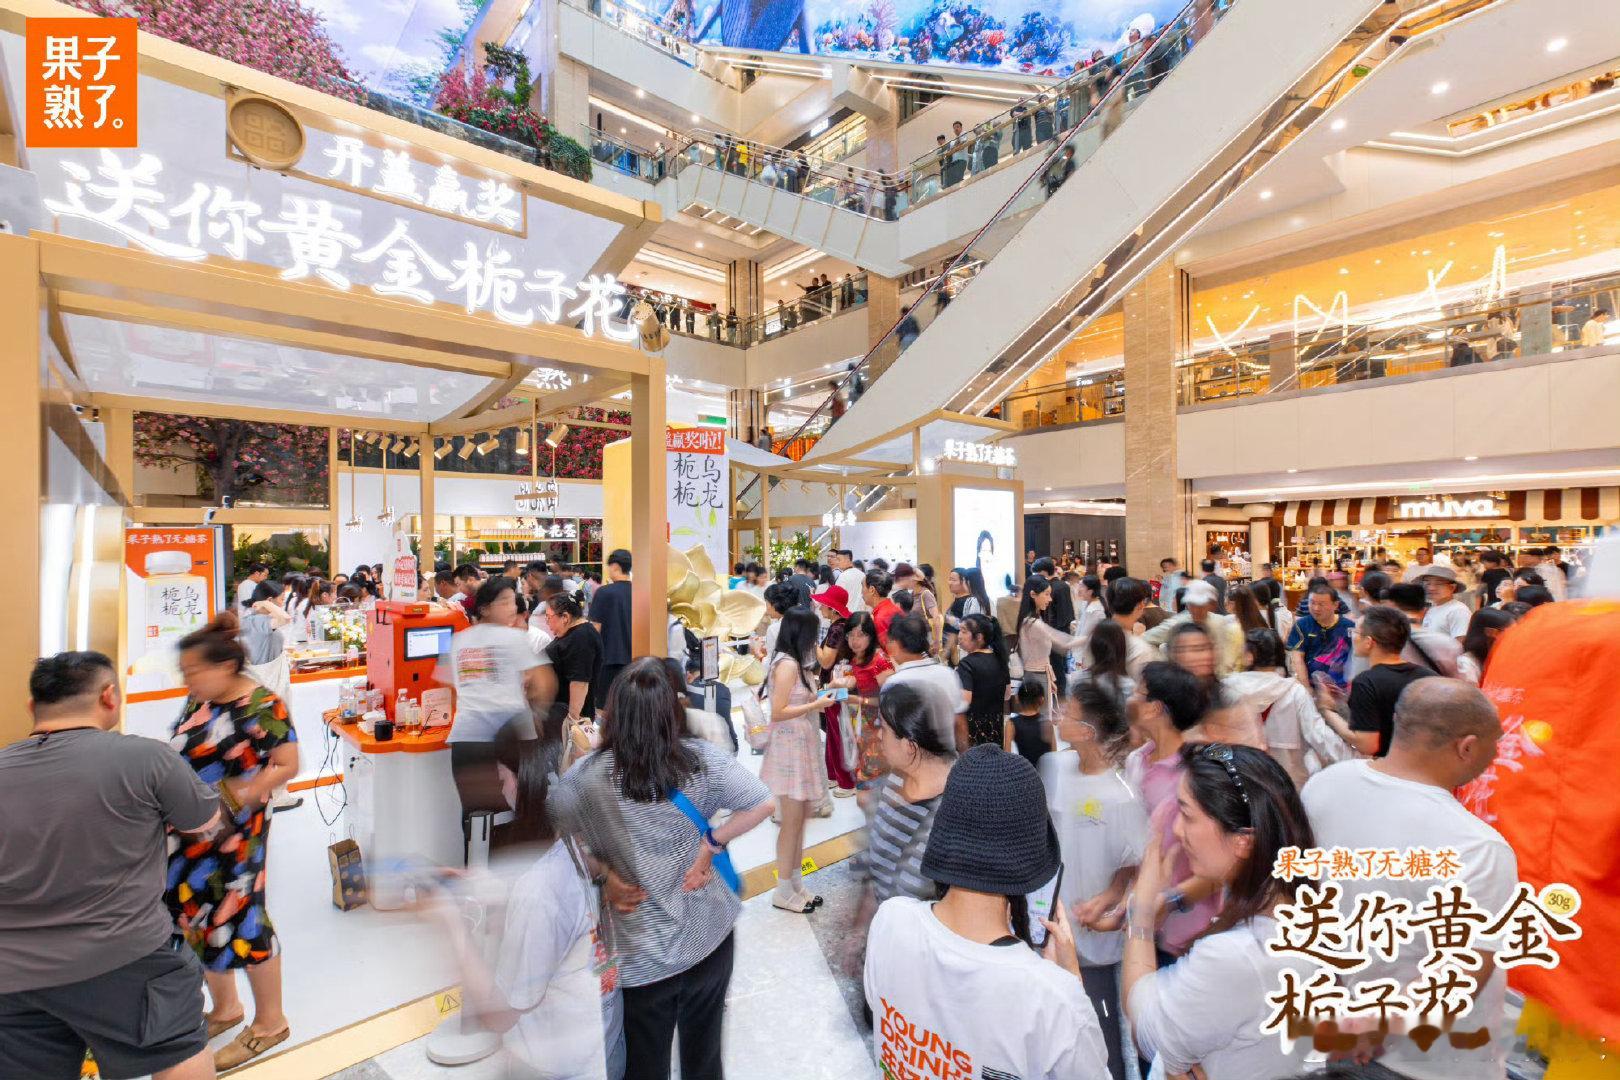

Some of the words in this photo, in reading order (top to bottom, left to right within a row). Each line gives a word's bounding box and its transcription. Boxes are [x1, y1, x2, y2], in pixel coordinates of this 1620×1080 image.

[323, 134, 521, 230] 开盖赢奖
[42, 147, 639, 342] 送你黄金栀子花
[127, 534, 208, 545] 果子熟了无糖茶
[880, 996, 973, 1075] YOUNG
